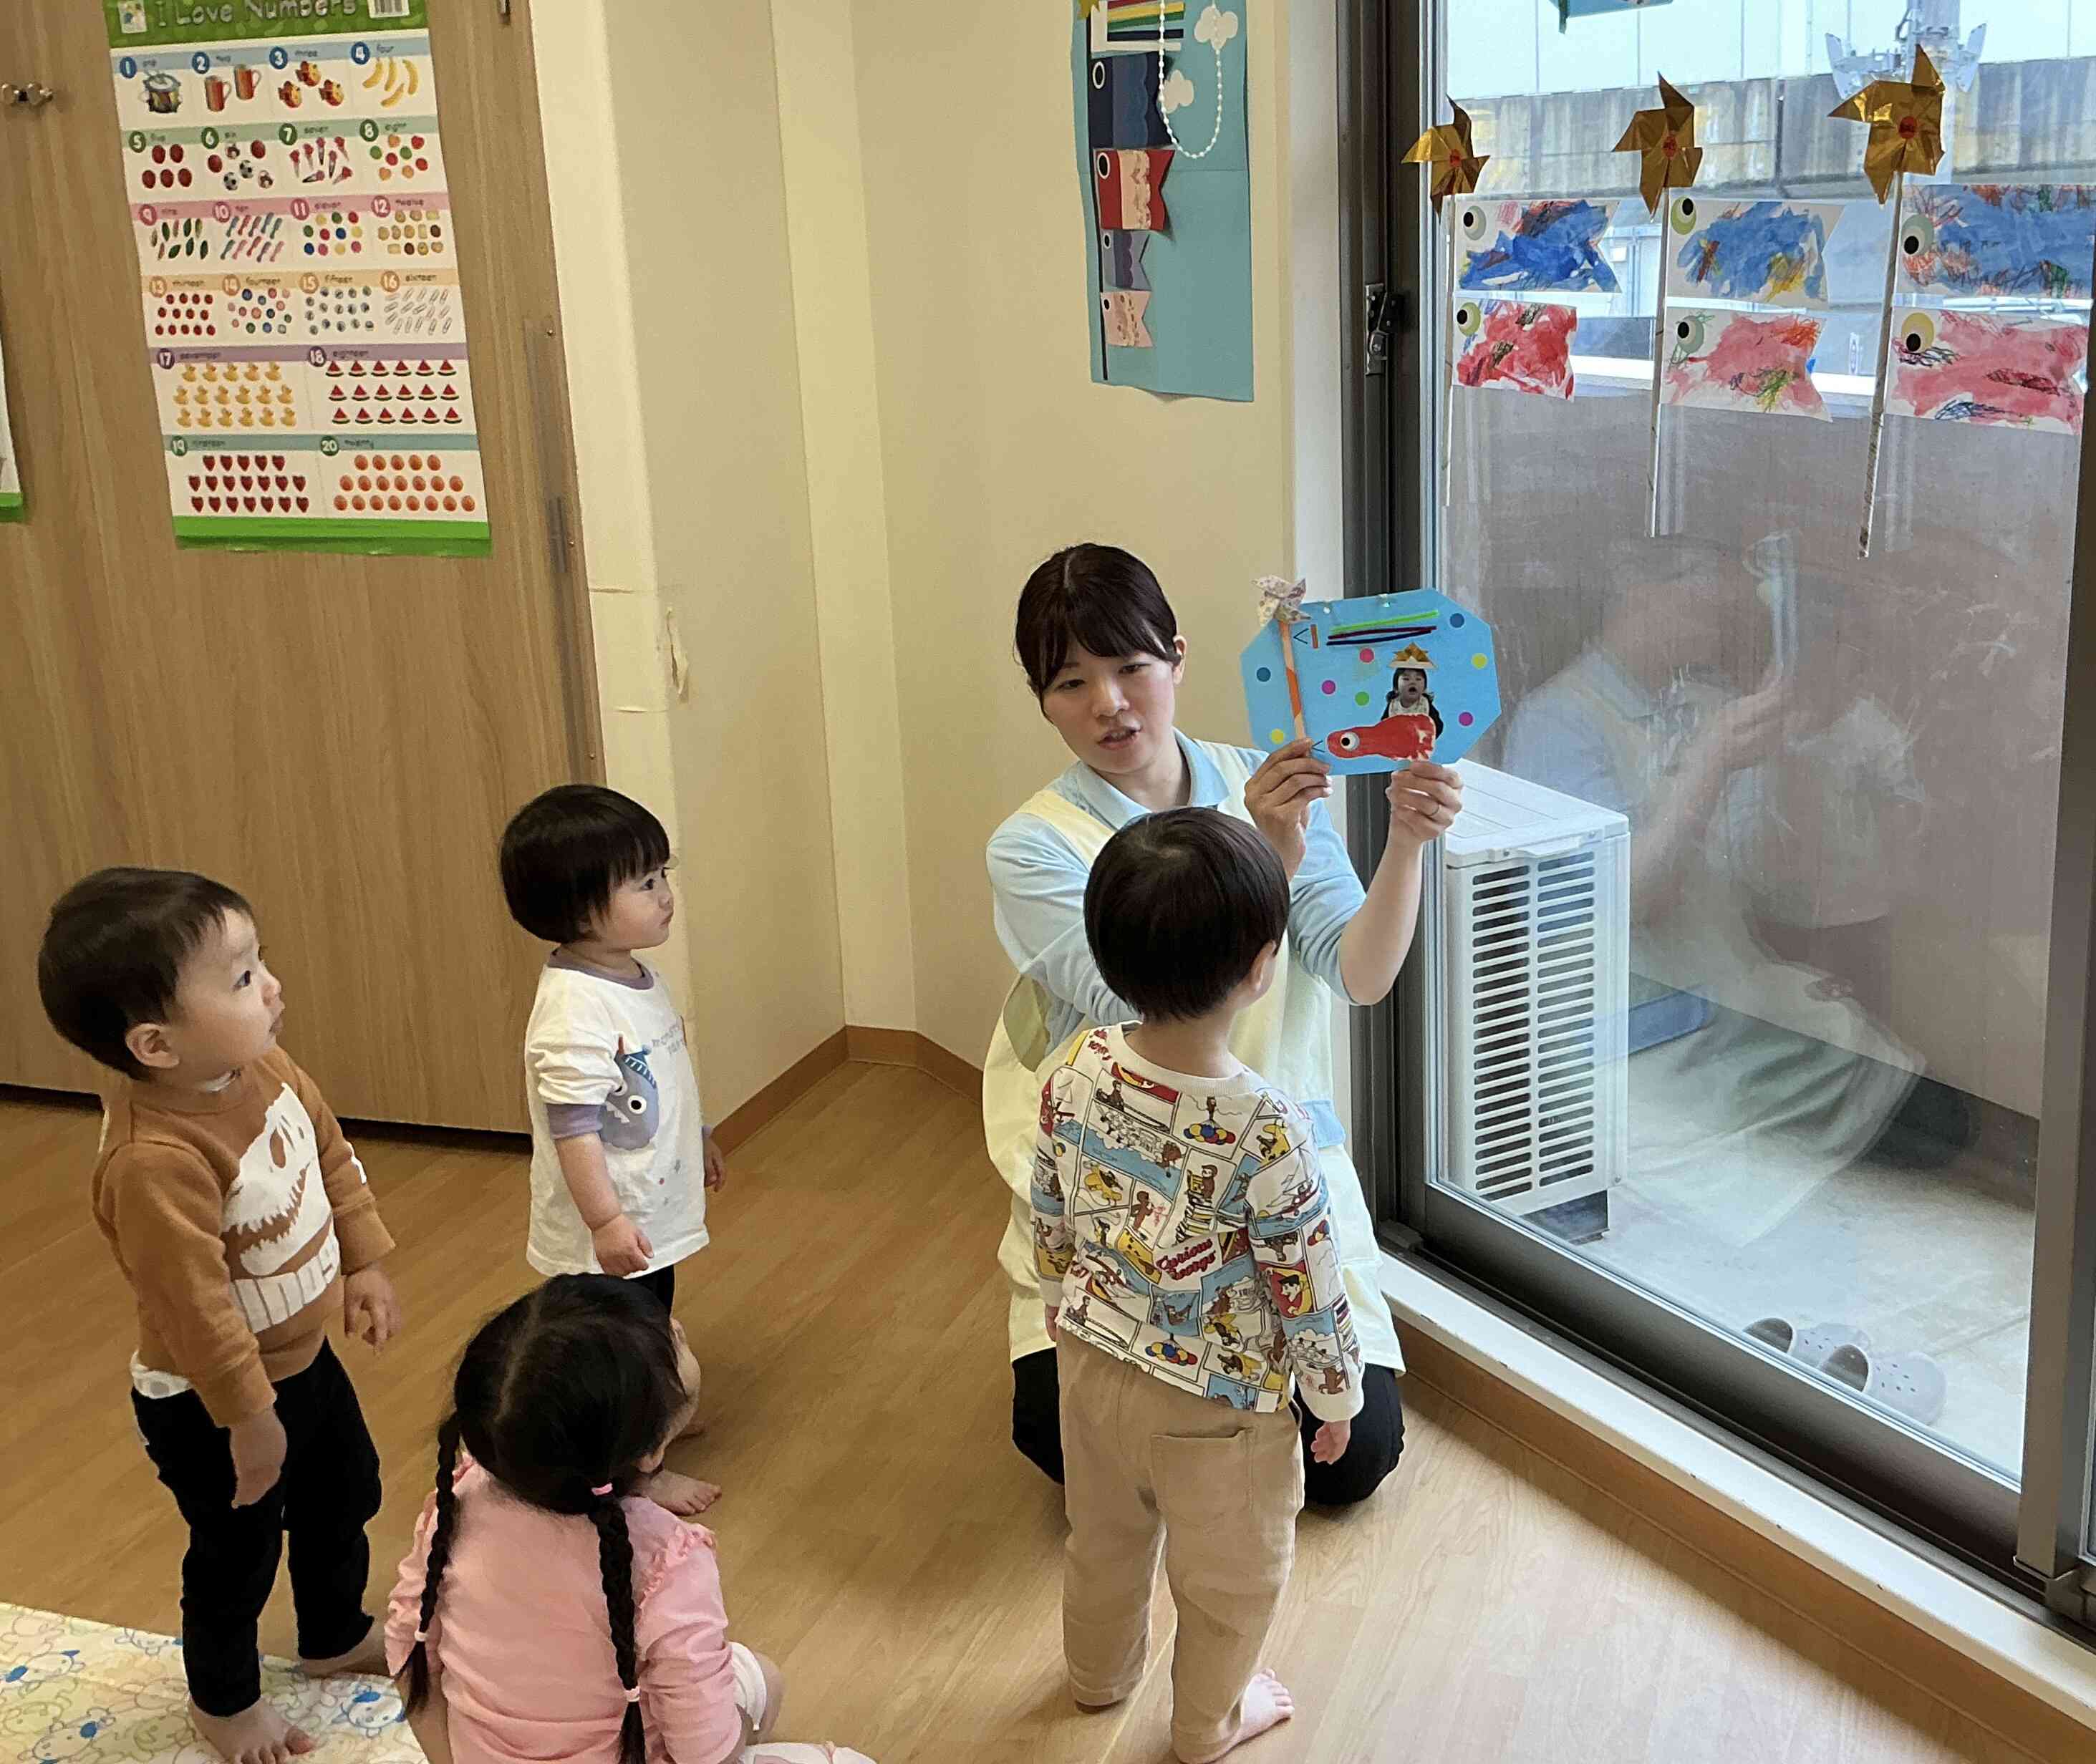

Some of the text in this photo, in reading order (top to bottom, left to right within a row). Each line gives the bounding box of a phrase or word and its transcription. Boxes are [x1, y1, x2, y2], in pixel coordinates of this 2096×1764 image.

[155, 0, 357, 27] I Love Numbers
[215, 203, 228, 219] 10
[373, 199, 387, 214] 12
[383, 274, 397, 289] 16
[309, 349, 324, 364] 18
[322, 440, 337, 452] 20
[1155, 1238, 1213, 1270] Curious
